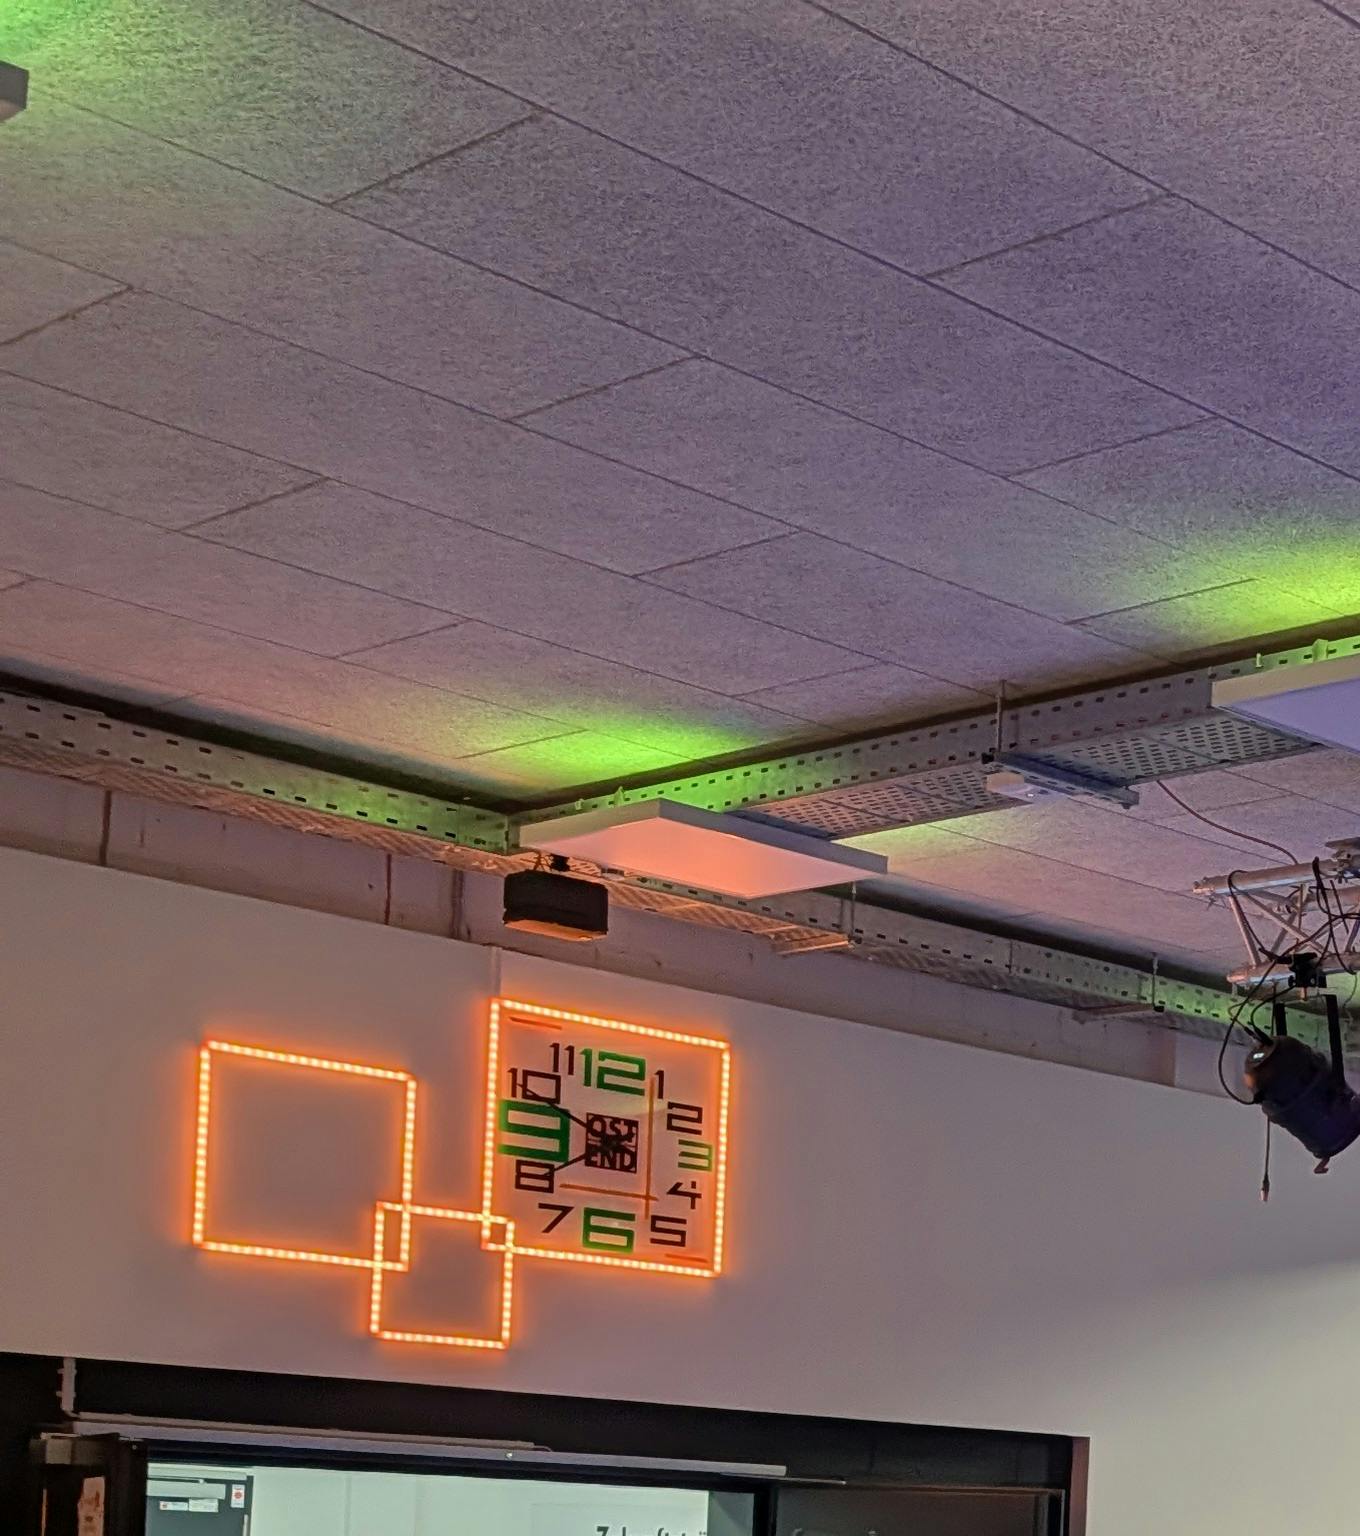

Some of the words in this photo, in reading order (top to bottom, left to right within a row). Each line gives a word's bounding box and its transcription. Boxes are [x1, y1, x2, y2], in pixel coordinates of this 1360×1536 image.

[550, 1043, 575, 1075] 11
[580, 1048, 646, 1096] 12
[508, 1068, 561, 1104] 10
[655, 1070, 664, 1099] 1
[499, 1100, 570, 1163] 9
[667, 1101, 703, 1135] 2
[678, 1139, 712, 1172] 3
[515, 1160, 555, 1193] 8
[666, 1181, 701, 1209] 4
[539, 1203, 574, 1233] 7
[582, 1207, 636, 1254] 6
[650, 1215, 687, 1247] 5
